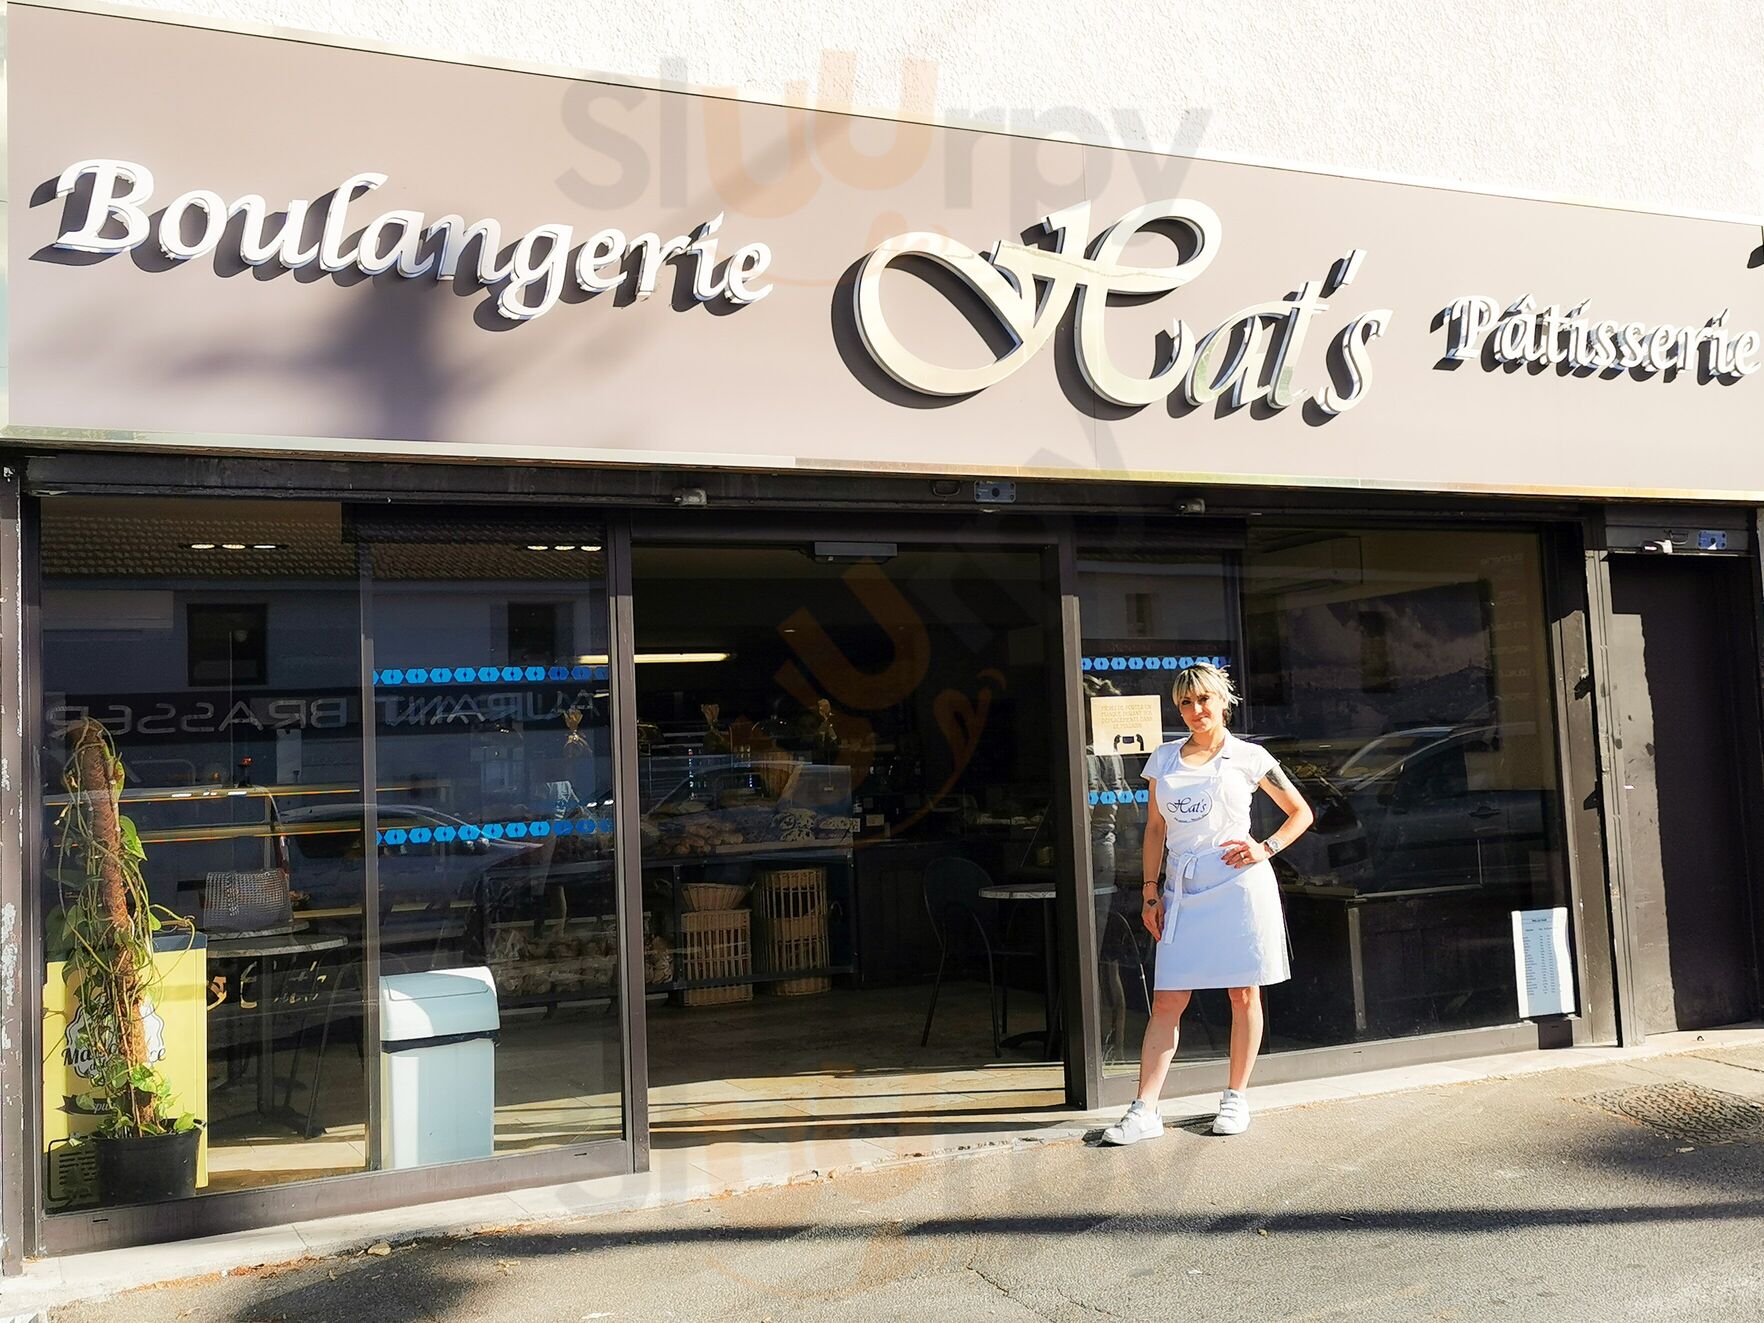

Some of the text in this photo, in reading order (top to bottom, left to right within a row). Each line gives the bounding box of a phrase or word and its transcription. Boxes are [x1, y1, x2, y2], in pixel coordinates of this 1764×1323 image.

[53, 158, 1761, 416] Boulangerie Hat's Pâtisserie
[1166, 797, 1207, 813] Hat's
